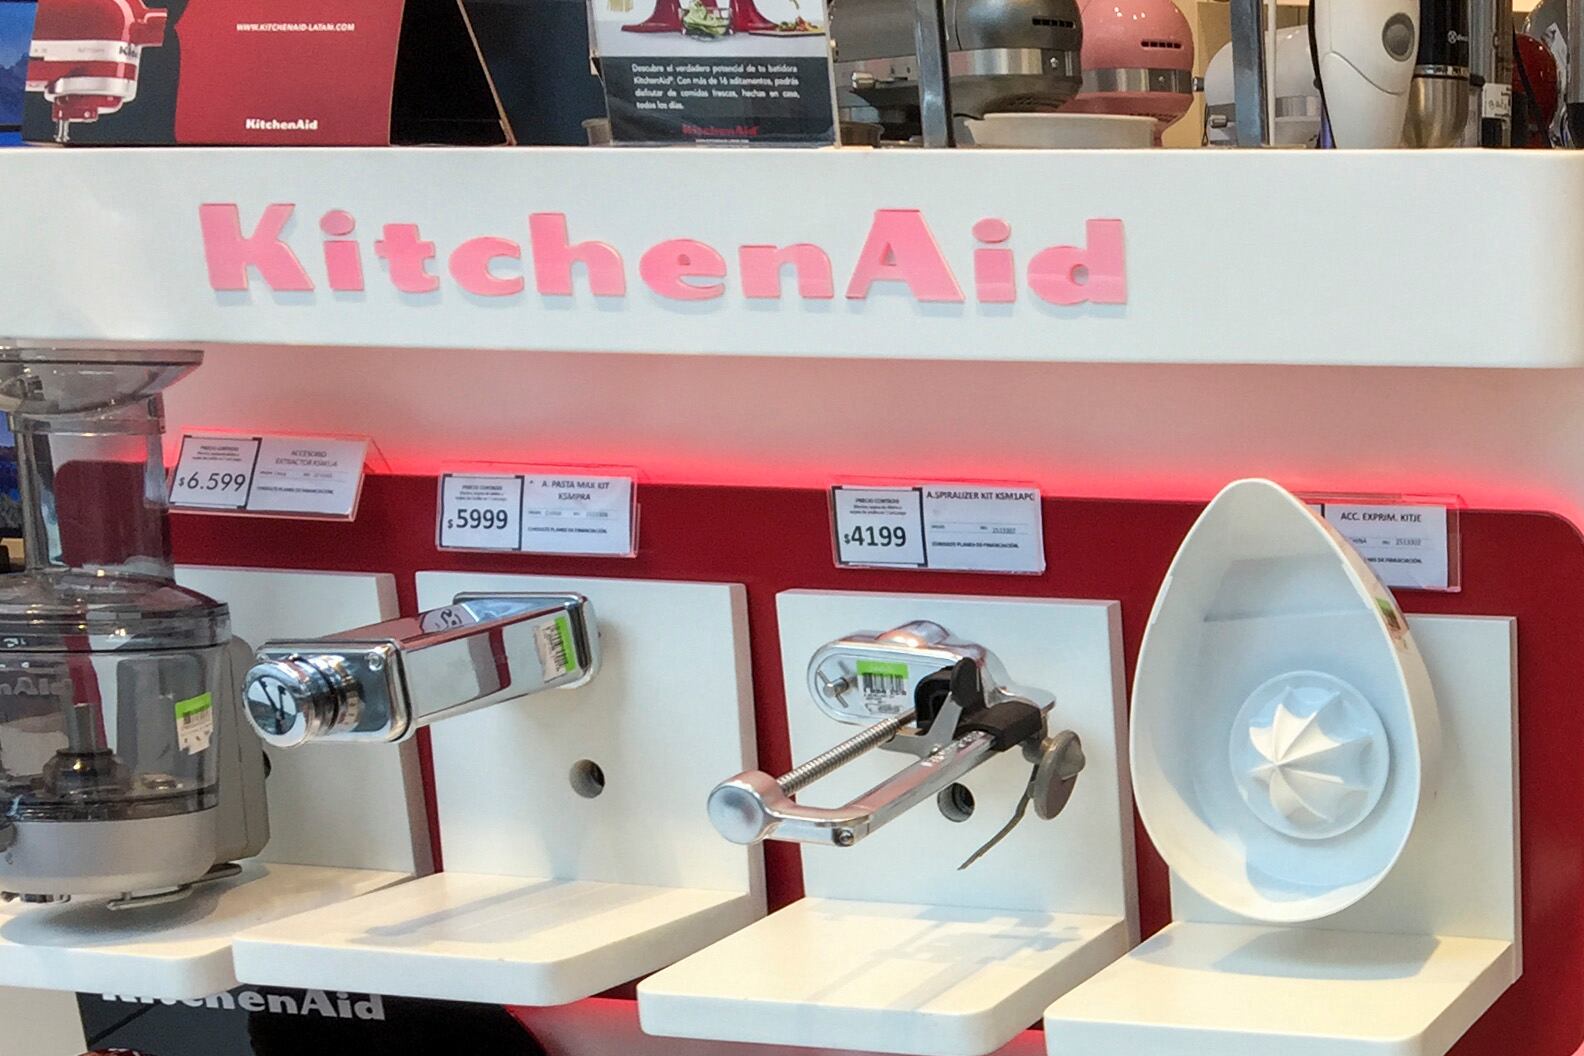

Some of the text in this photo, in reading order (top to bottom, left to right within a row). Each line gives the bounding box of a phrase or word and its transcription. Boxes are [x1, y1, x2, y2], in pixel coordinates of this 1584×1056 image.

[236, 23, 356, 32] WWW.KITCHENAID-LATAM.COM
[245, 118, 319, 131] KitchenAid
[199, 203, 1128, 305] KitchenAid
[551, 480, 576, 490] PASTA
[981, 492, 994, 501] KIT
